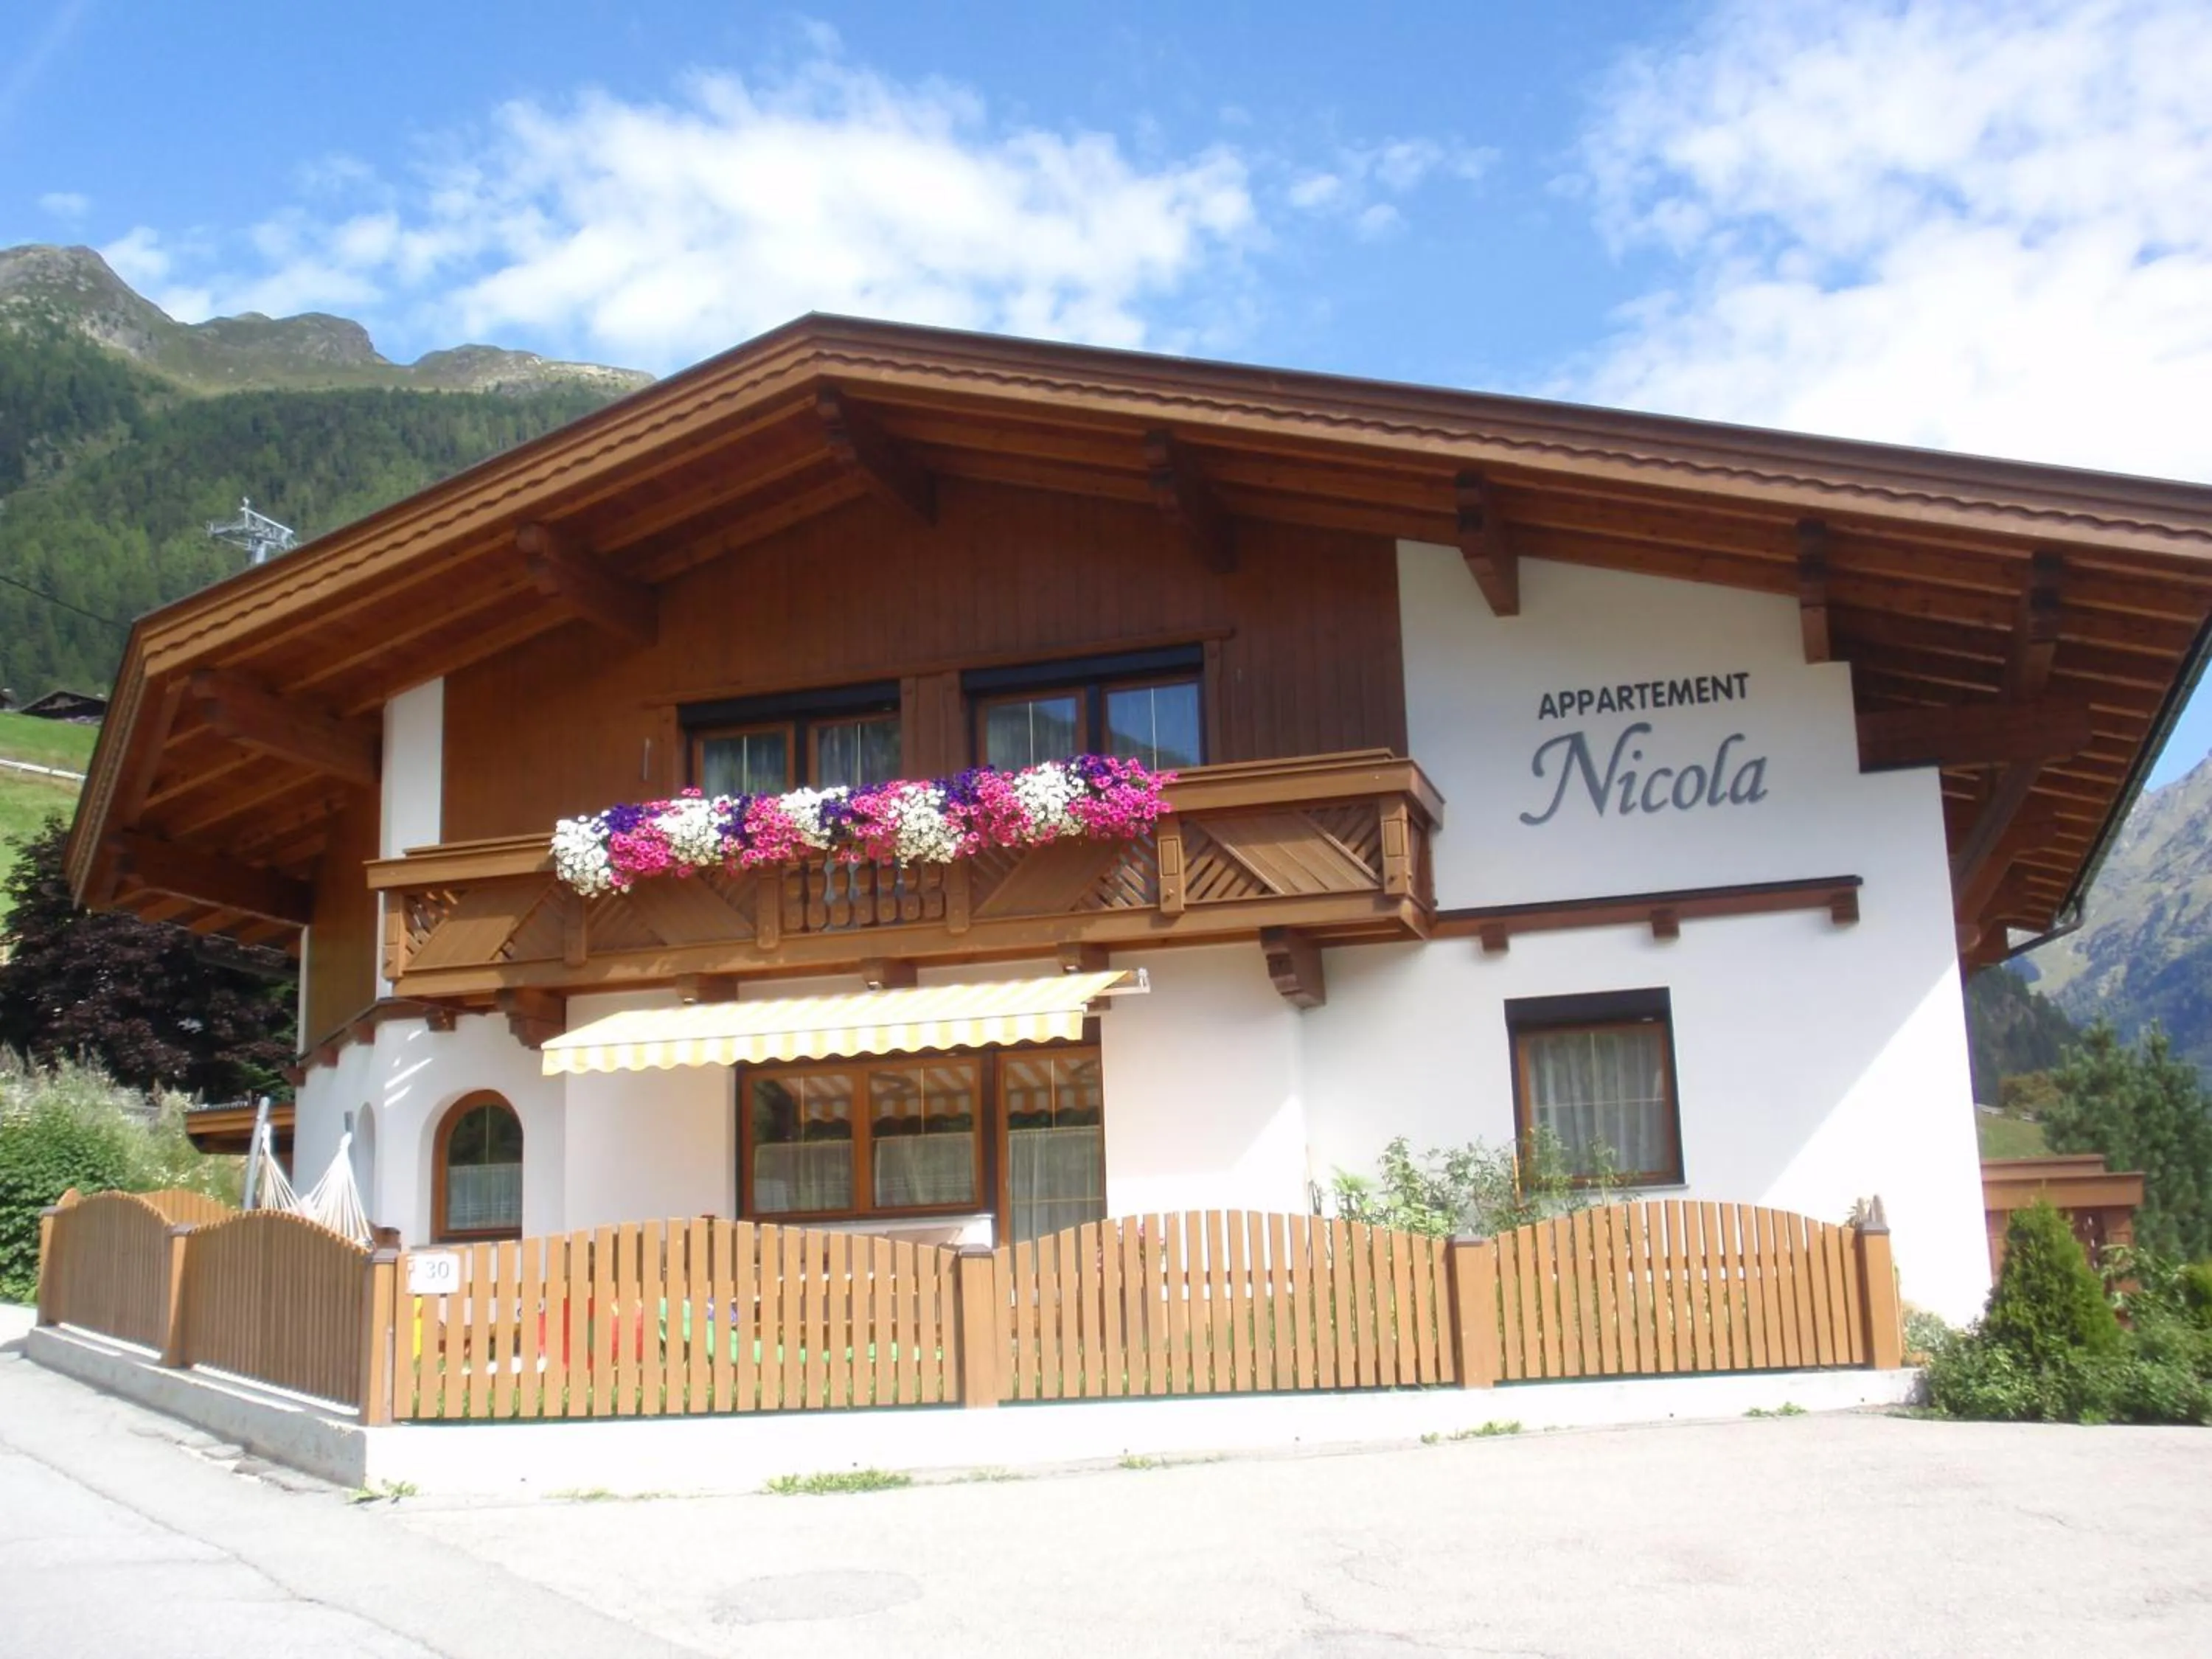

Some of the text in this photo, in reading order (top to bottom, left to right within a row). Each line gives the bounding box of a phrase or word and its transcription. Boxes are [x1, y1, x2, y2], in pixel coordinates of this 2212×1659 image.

[1538, 672, 1750, 720] APPARTEMENT
[1520, 722, 1768, 826] Nicola
[425, 1261, 449, 1279] 30
